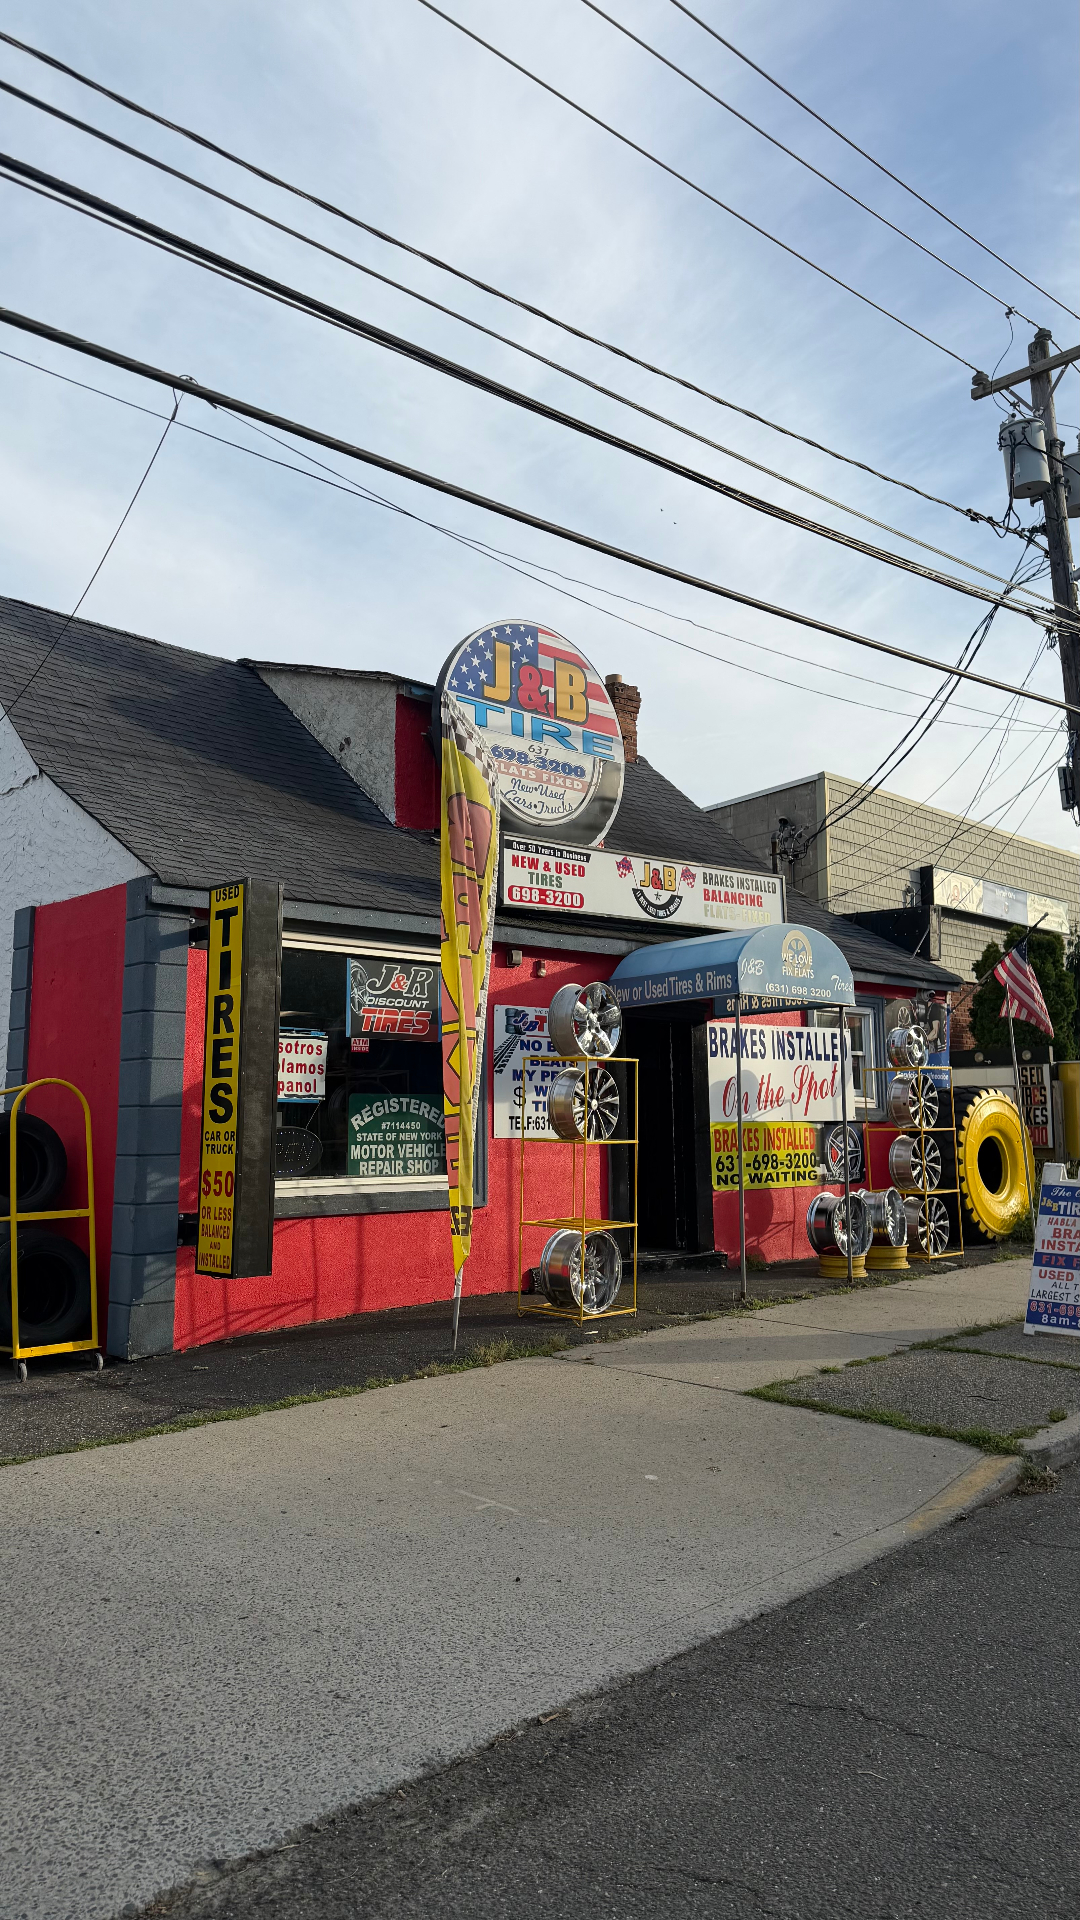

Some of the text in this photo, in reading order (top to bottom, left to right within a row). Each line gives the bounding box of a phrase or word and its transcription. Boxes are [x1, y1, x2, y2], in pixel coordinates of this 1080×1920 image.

[482, 638, 589, 726] J&B
[456, 695, 616, 761] TIRE
[490, 744, 586, 779] 698-3200
[511, 778, 567, 801] New Used
[542, 773, 583, 790] FIXED
[504, 789, 574, 814] Cars Trucks
[512, 842, 527, 850] Over
[528, 844, 536, 852] 50
[538, 846, 554, 855] Years
[562, 851, 587, 861] Business
[511, 854, 586, 878] NEW & USED
[528, 871, 563, 888] TIRES
[639, 861, 677, 892] J&B
[702, 871, 777, 894] BRAKES INSTALLED
[215, 885, 240, 903] USED
[512, 886, 581, 907] 698-3200
[703, 888, 763, 908] BALANCING
[781, 952, 813, 965] WE LOVE
[741, 957, 765, 981] J&B
[782, 966, 815, 979] FIX FLATS
[366, 963, 434, 998] J&R
[632, 986, 643, 1000] or
[644, 978, 668, 999] Used
[669, 976, 693, 996] Tires
[695, 973, 704, 992] &
[706, 971, 732, 991] Rims
[830, 974, 853, 992] Tires
[765, 982, 832, 998] (631) 698 3200
[366, 996, 430, 1009] DISCOUNT
[208, 906, 238, 1124] TIRES
[361, 1006, 432, 1036] TIRES
[352, 1038, 369, 1046] ATM
[520, 1040, 542, 1051] NO
[708, 1026, 766, 1060] BRAKES
[278, 1057, 325, 1075] lamos
[512, 1069, 537, 1081] MY
[1018, 1066, 1044, 1085] SED
[722, 1062, 838, 1118] On the Spot
[1016, 1086, 1047, 1105] IRES
[350, 1097, 445, 1131] REGISTERED
[381, 1121, 421, 1130] #7114450
[204, 1130, 236, 1142] CAR OR
[356, 1131, 443, 1141] STATE OF NEW YORK
[713, 1126, 816, 1153] BRAKES INSTALLED
[205, 1143, 234, 1155] TRUCK
[350, 1142, 446, 1159] MOTOR VEHICLE
[359, 1159, 439, 1176] REPAIR SHOP
[715, 1152, 817, 1173] 63-698-3200
[201, 1168, 234, 1199] $50
[748, 1169, 818, 1185] WAITING
[1050, 1186, 1072, 1197] The
[1041, 1196, 1058, 1212] J&B
[201, 1206, 232, 1222] OR LESS
[1047, 1216, 1077, 1227] HABLA
[201, 1223, 230, 1240] BALANCED
[209, 1241, 221, 1251] AND
[198, 1251, 230, 1270] INSTALLED
[1042, 1255, 1066, 1266] FIX
[1038, 1268, 1075, 1282] USED
[1051, 1281, 1070, 1290] ALL
[1030, 1288, 1072, 1302] LARGEST
